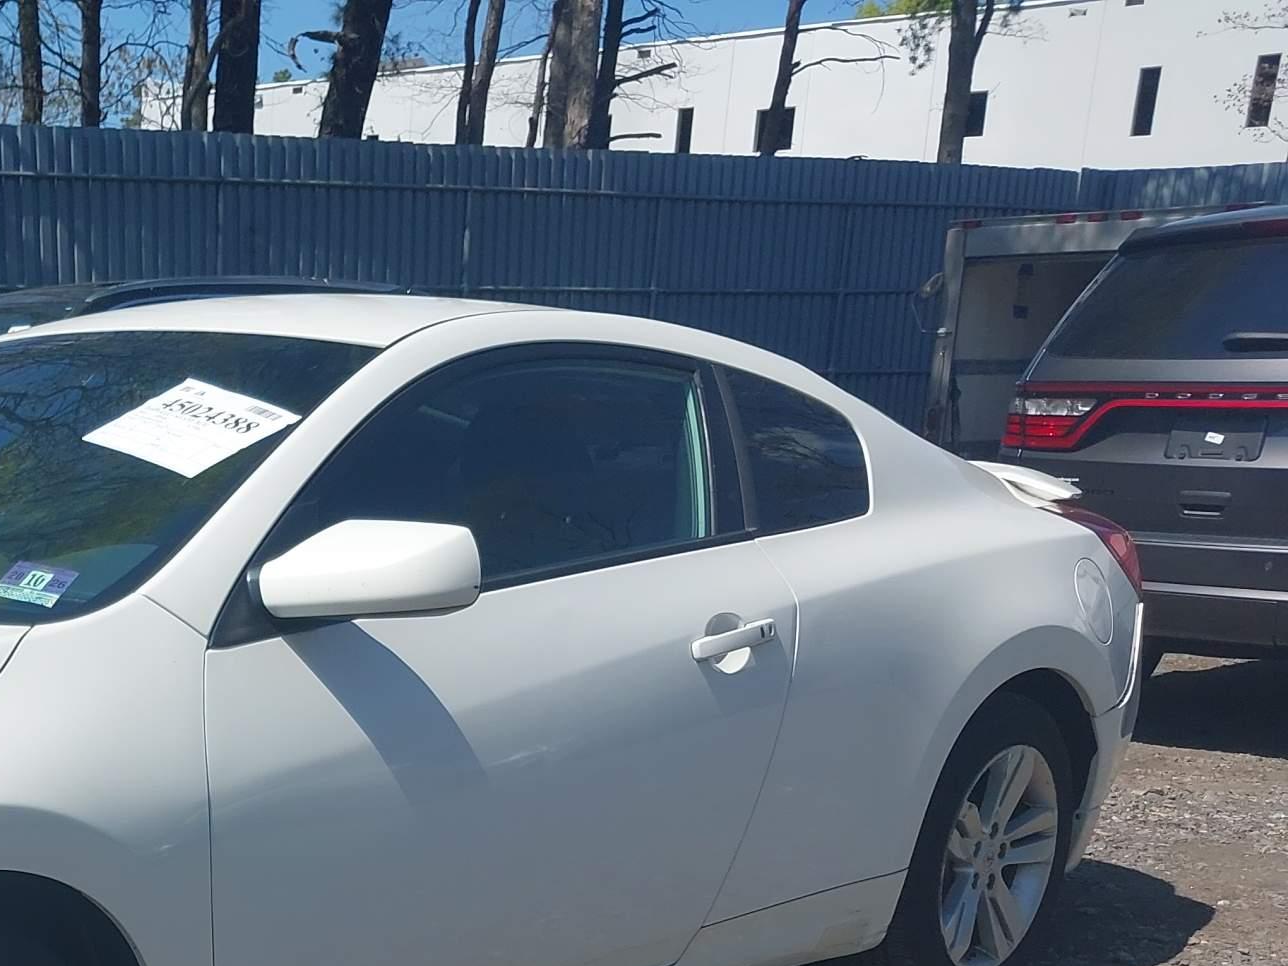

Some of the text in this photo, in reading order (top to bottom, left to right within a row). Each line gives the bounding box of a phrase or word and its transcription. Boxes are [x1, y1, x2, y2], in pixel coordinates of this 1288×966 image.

[162, 398, 260, 434] 45024388
[23, 573, 46, 588] 10
[49, 578, 66, 589] 26
